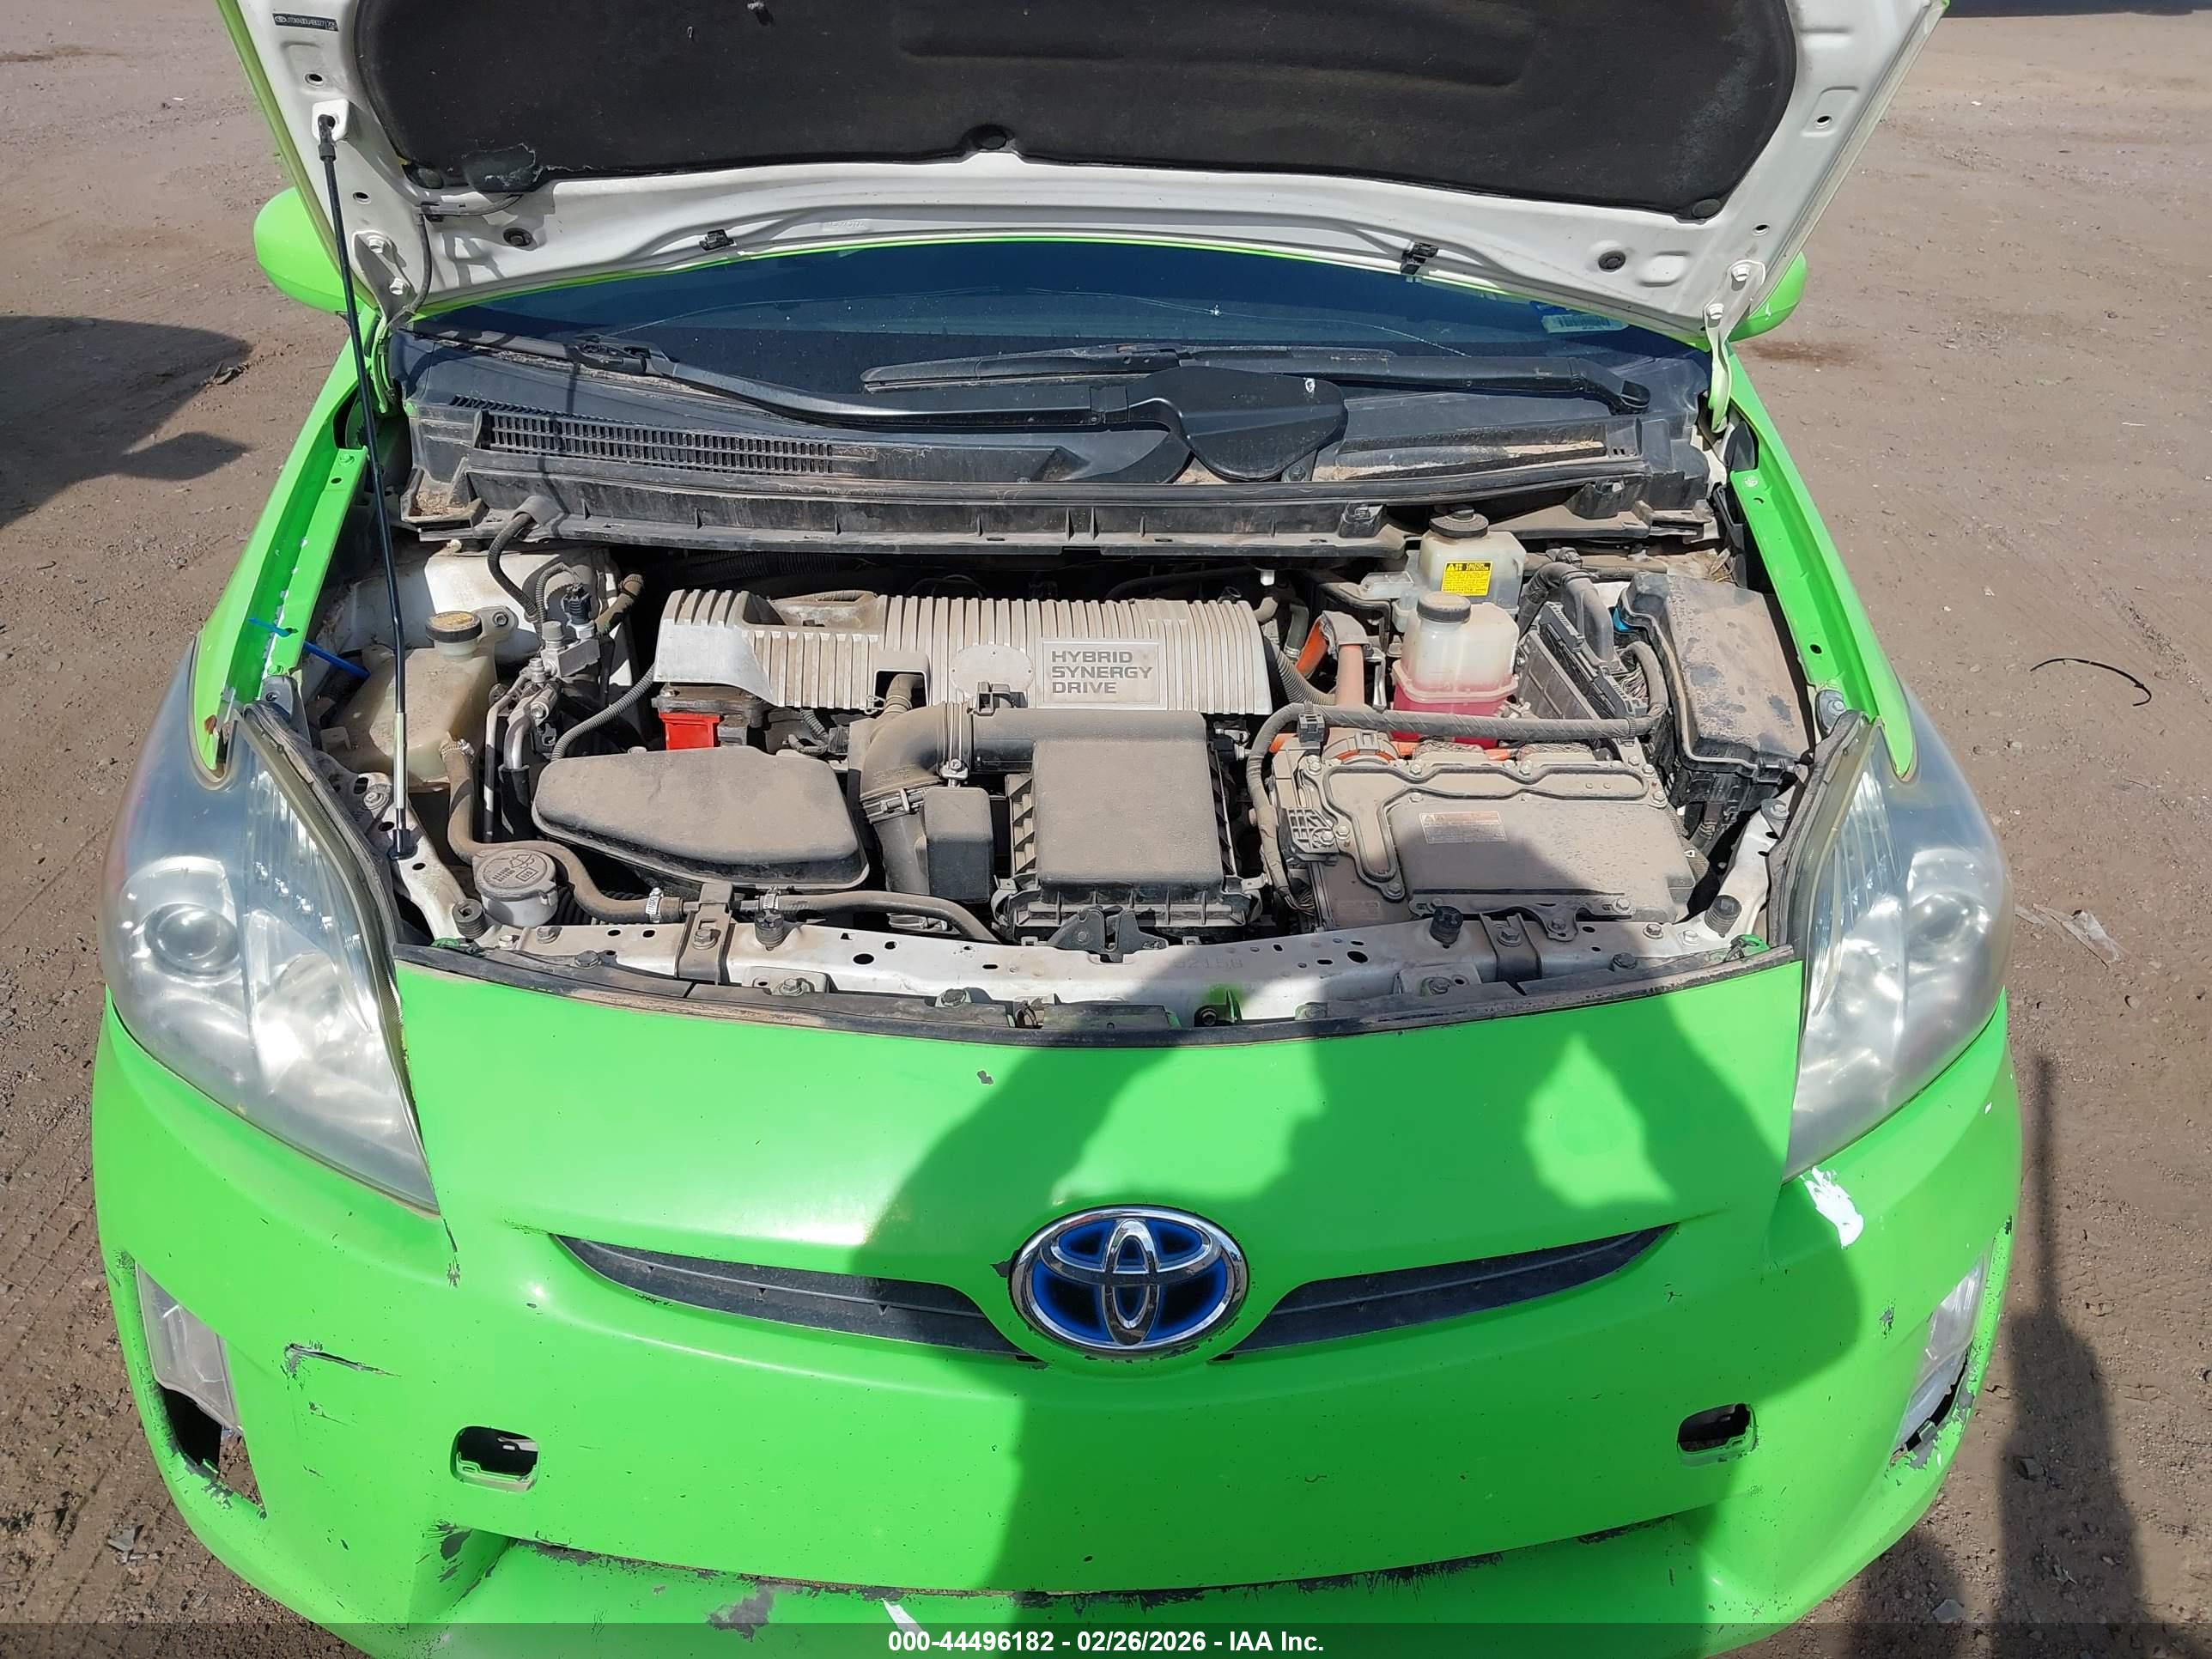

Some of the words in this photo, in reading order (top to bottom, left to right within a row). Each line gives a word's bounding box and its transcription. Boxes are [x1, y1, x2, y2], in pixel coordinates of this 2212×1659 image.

[1052, 651, 1133, 663] HYBRID
[1052, 665, 1153, 678] SYNERGY
[1052, 682, 1117, 694] DRIVE
